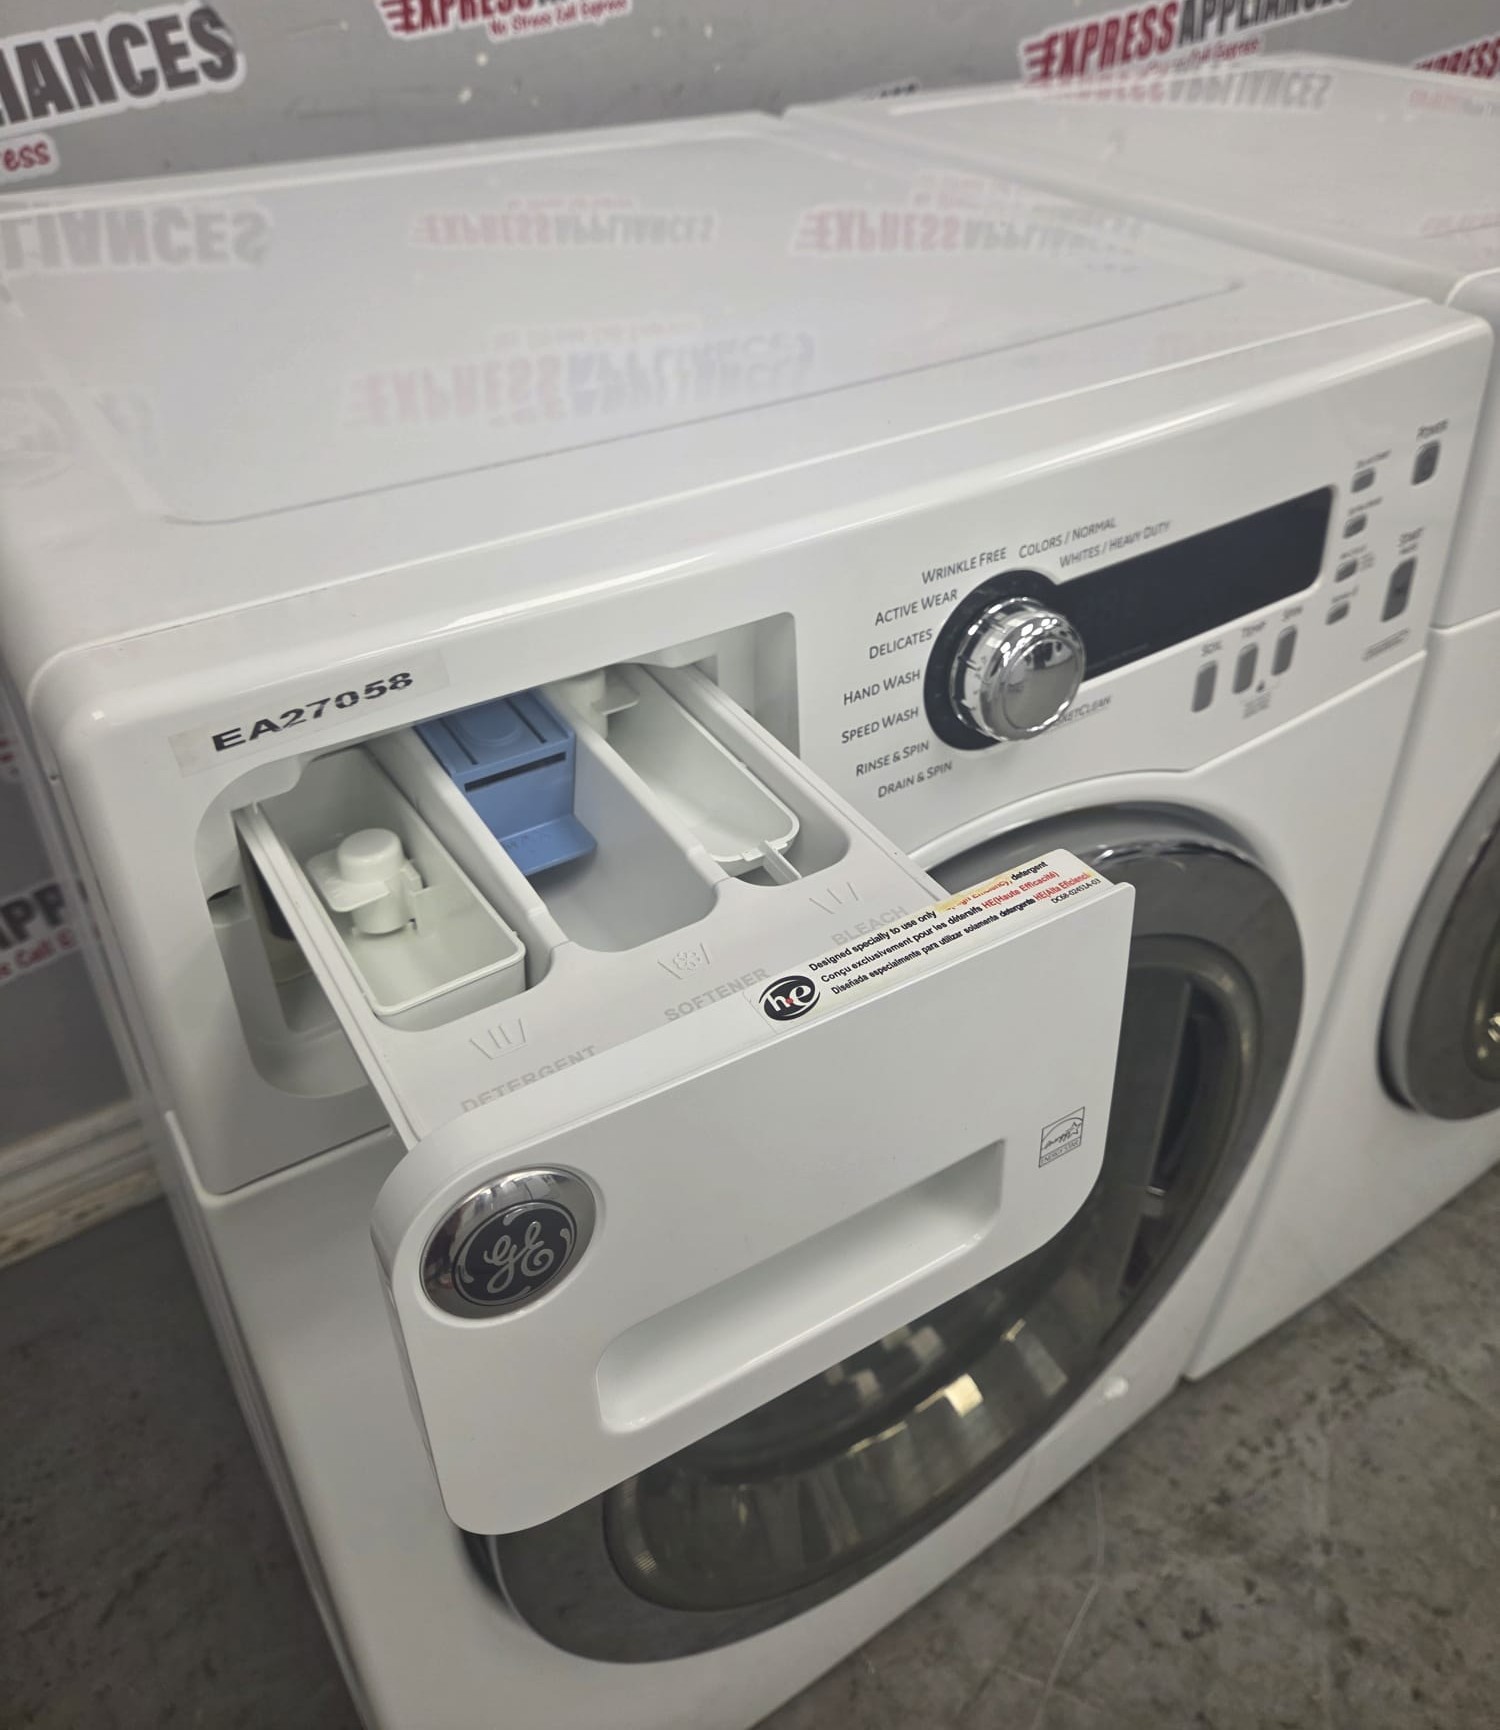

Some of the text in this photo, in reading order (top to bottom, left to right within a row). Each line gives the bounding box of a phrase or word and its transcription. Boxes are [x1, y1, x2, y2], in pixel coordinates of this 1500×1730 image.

[0, 5, 238, 126] IANCES
[1018, 534, 1063, 559] COLORS
[1071, 517, 1117, 541] NORMAL
[1059, 544, 1100, 568] WHITES
[1109, 530, 1141, 551] HEAVY
[1143, 520, 1172, 540] DUTY
[921, 547, 1007, 585] WRINKLE FREE
[874, 588, 958, 627] ACTIVE WEAR
[868, 628, 934, 660] DELICATES
[843, 669, 921, 706] HAND WASH
[212, 672, 413, 751] EA27058
[841, 706, 919, 744] SPEED WASH
[855, 740, 930, 777] RINSE & SPIN
[877, 760, 953, 798] DRAIN & SPIN
[808, 947, 853, 972] Designed
[851, 931, 891, 953] specially
[889, 926, 901, 935] to
[900, 919, 918, 931] use
[917, 909, 937, 923] only
[1010, 861, 1049, 881] detergent
[830, 906, 909, 946] BLEACH
[820, 966, 852, 983] Conçu
[851, 936, 914, 970] exclusivement
[912, 927, 934, 943] pour
[934, 922, 948, 932] les
[830, 973, 870, 995] Diseñada
[868, 949, 922, 979] especialmente
[921, 941, 940, 955] para
[939, 930, 963, 946] utilizar
[663, 967, 771, 1022] SOFTENER
[460, 1044, 595, 1113] DETERGENT
